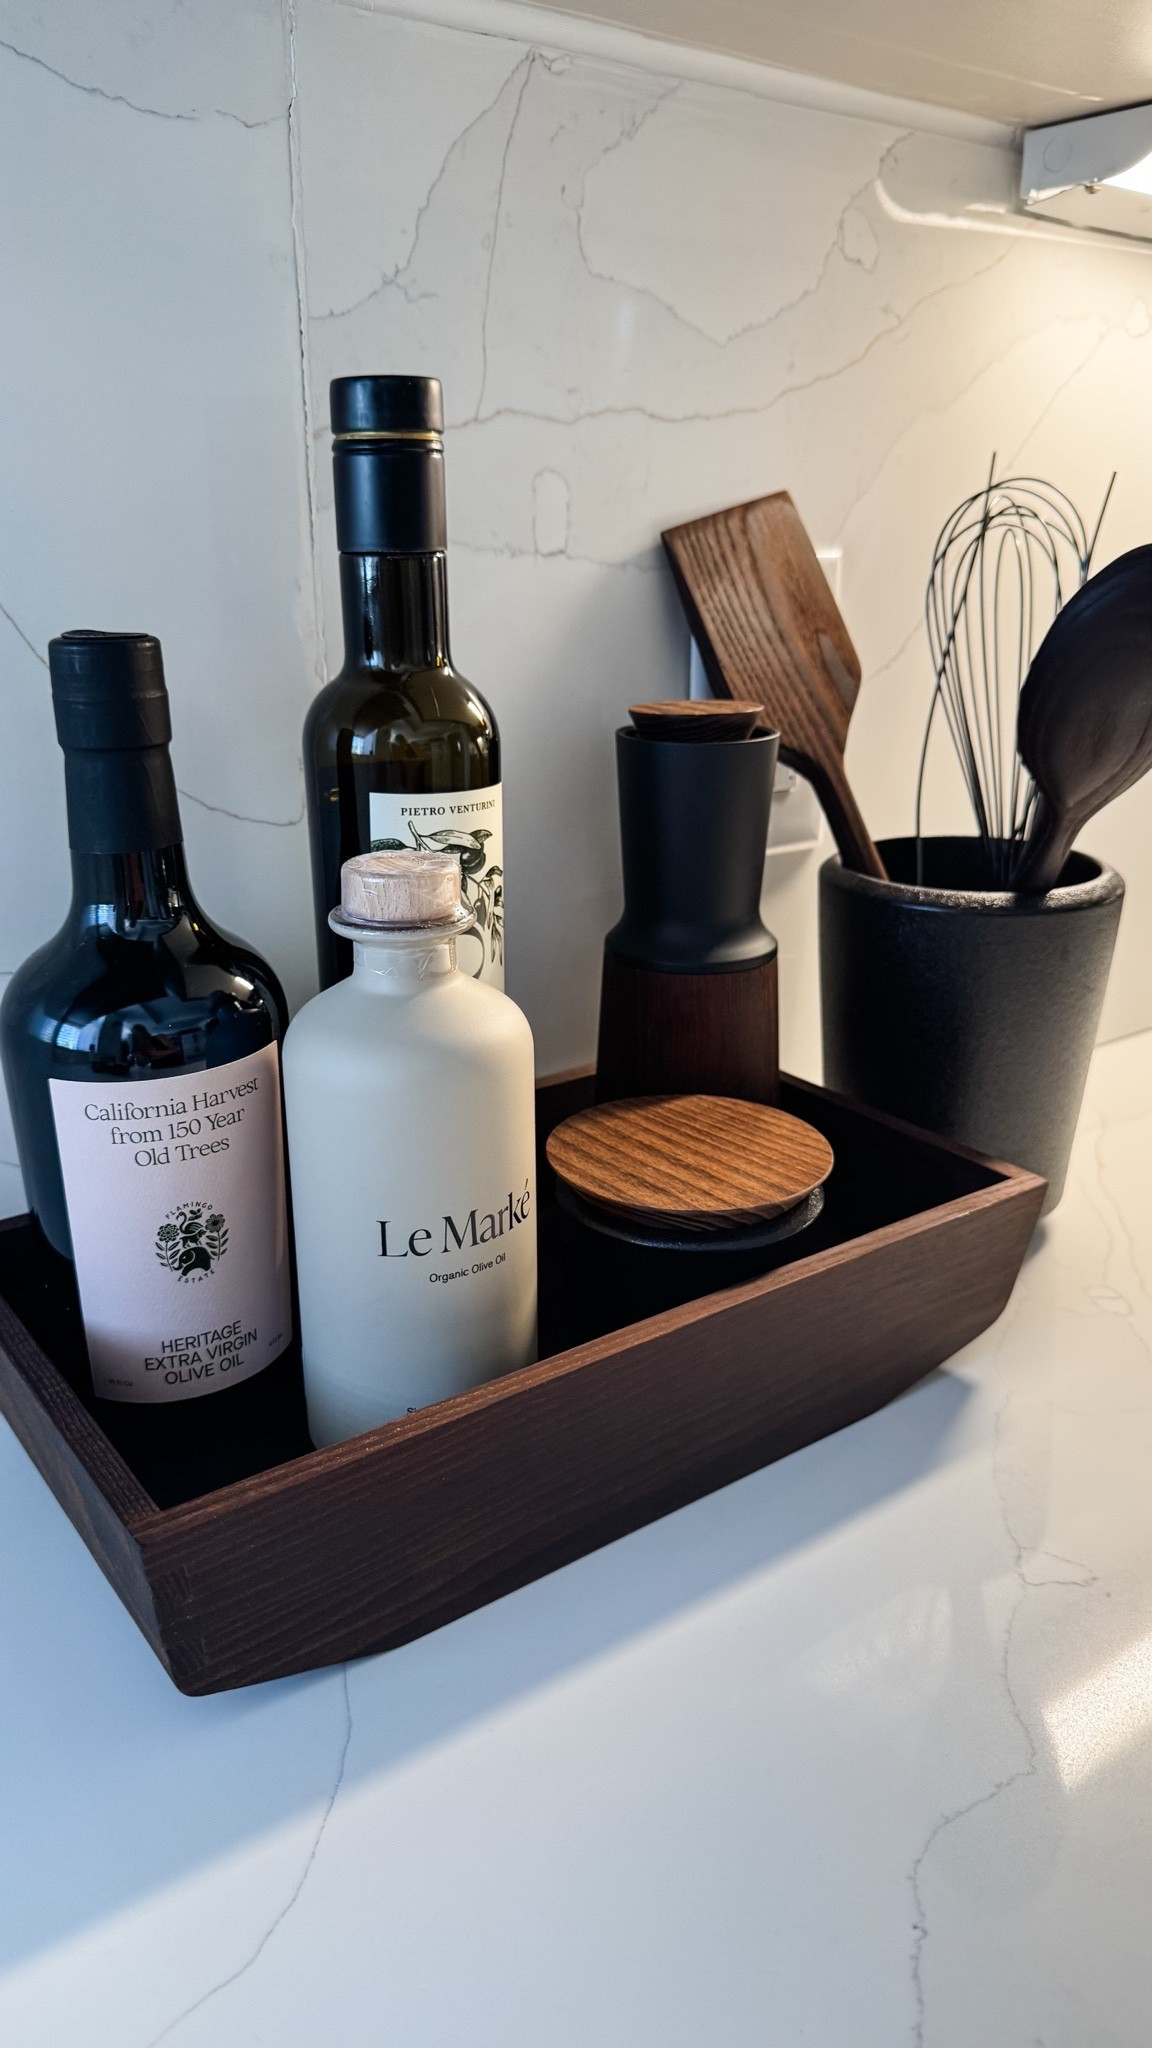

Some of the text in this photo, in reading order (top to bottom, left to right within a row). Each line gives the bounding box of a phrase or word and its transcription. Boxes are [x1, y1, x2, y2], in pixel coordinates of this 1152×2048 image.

[400, 799, 495, 816] PIETRO VENTURINI
[84, 1077, 260, 1121] California Harvest
[111, 1107, 246, 1145] from 150 Year
[134, 1137, 230, 1167] Old Trees
[164, 1201, 214, 1220] FLAMINGO
[375, 1178, 531, 1258] Le Marké
[429, 1252, 507, 1284] Organic Olive Oil
[144, 1351, 203, 1371] EXTRA
[206, 1328, 258, 1360] VIRGIN
[161, 1320, 242, 1354] HERITAGE
[164, 1352, 245, 1385] OLIVE OIL
